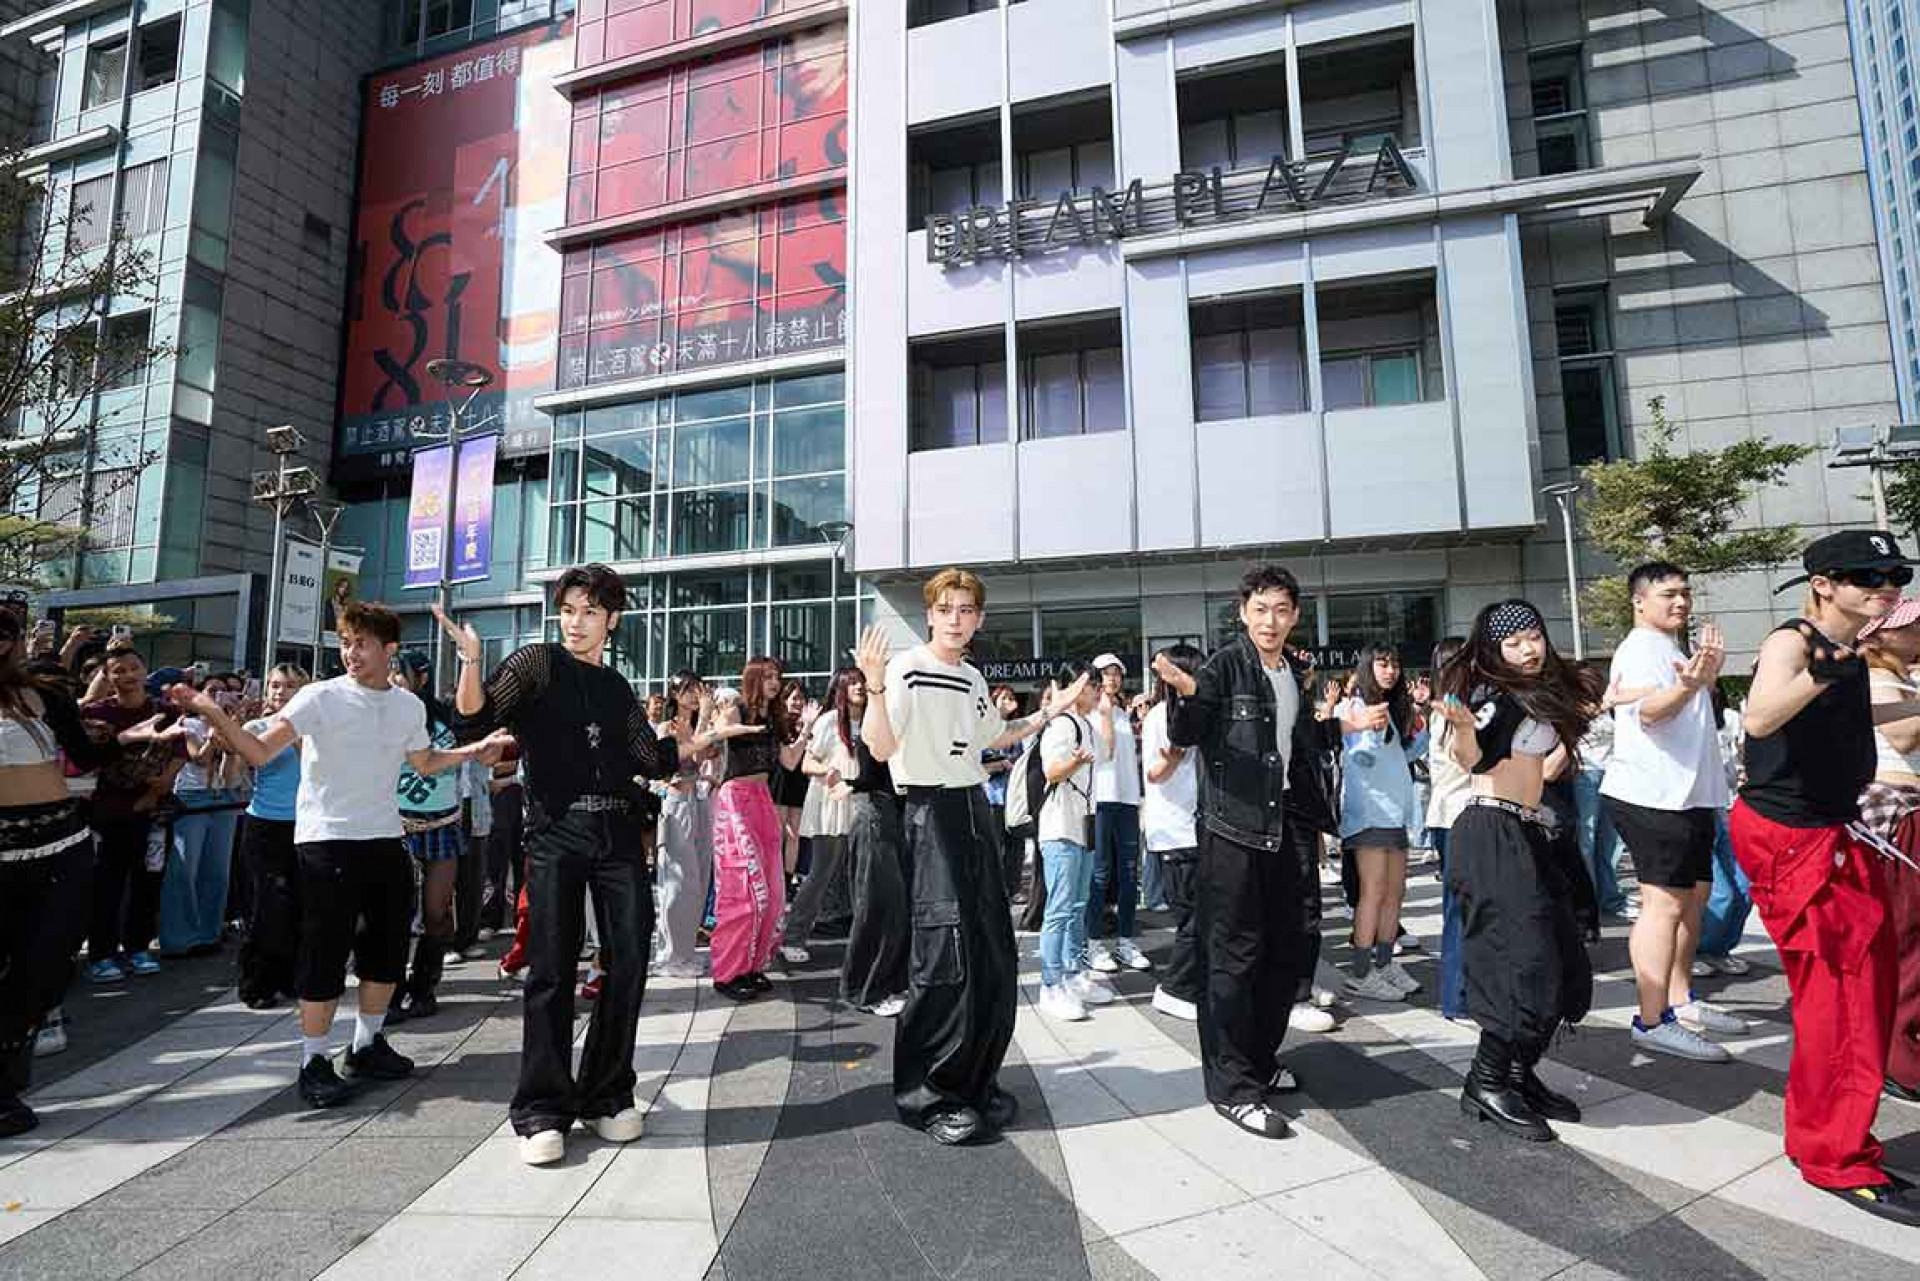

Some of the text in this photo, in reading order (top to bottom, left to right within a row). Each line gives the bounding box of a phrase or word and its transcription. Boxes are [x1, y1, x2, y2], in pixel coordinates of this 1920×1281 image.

[379, 47, 521, 108] 每一刻 都值得
[925, 135, 1418, 265] DREAM PLAZA
[983, 661, 1077, 679] DREAM PLA
[1329, 649, 1362, 666] PLA
